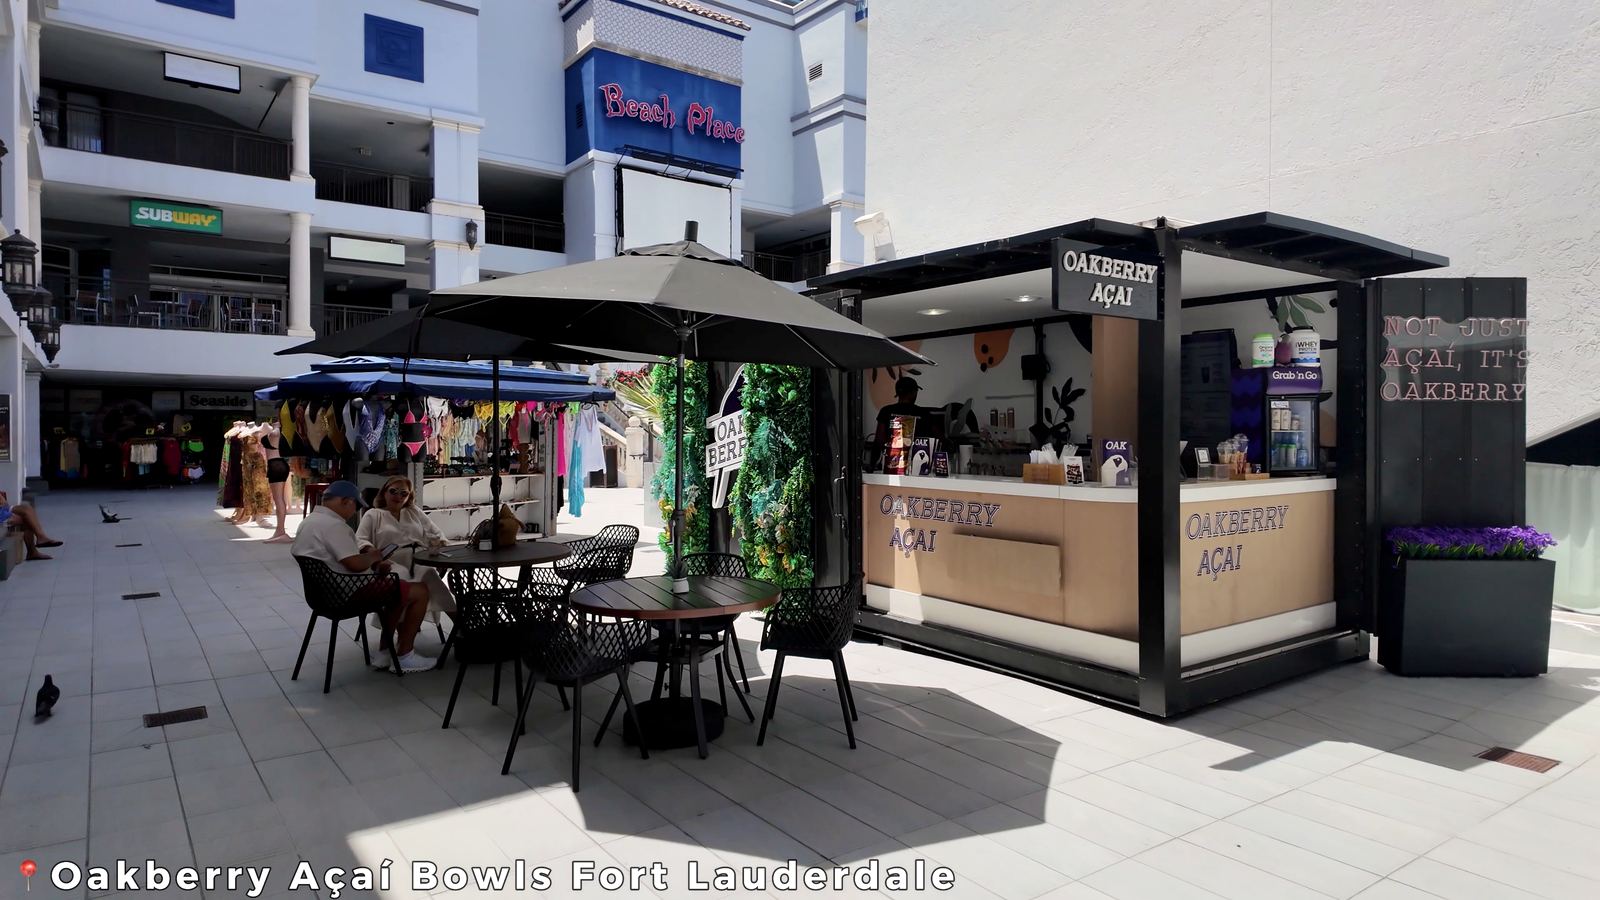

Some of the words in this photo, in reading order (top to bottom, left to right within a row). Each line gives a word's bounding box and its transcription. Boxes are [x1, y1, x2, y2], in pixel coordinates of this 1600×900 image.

[599, 83, 676, 129] Beach
[687, 102, 746, 144] Place
[135, 206, 217, 227] SUBWAY
[1063, 250, 1158, 284] OAKBERRY
[1090, 282, 1134, 309] AÇAI
[1383, 316, 1441, 337] NOT
[1459, 317, 1530, 337] JUST
[1382, 341, 1462, 375] AÇAÍ,
[1480, 349, 1530, 369] IT'S
[1272, 370, 1296, 380] Grab
[1305, 371, 1318, 380] Go
[189, 394, 248, 407] Seaside
[1380, 381, 1527, 402] OAKBERRY
[915, 438, 928, 447] OAK
[1105, 441, 1128, 450] OAK
[880, 494, 1002, 527] OAKBERRY
[1185, 505, 1290, 540] OAKBERRY
[889, 527, 937, 559] AÇAI
[1197, 544, 1243, 581] AÇAI
